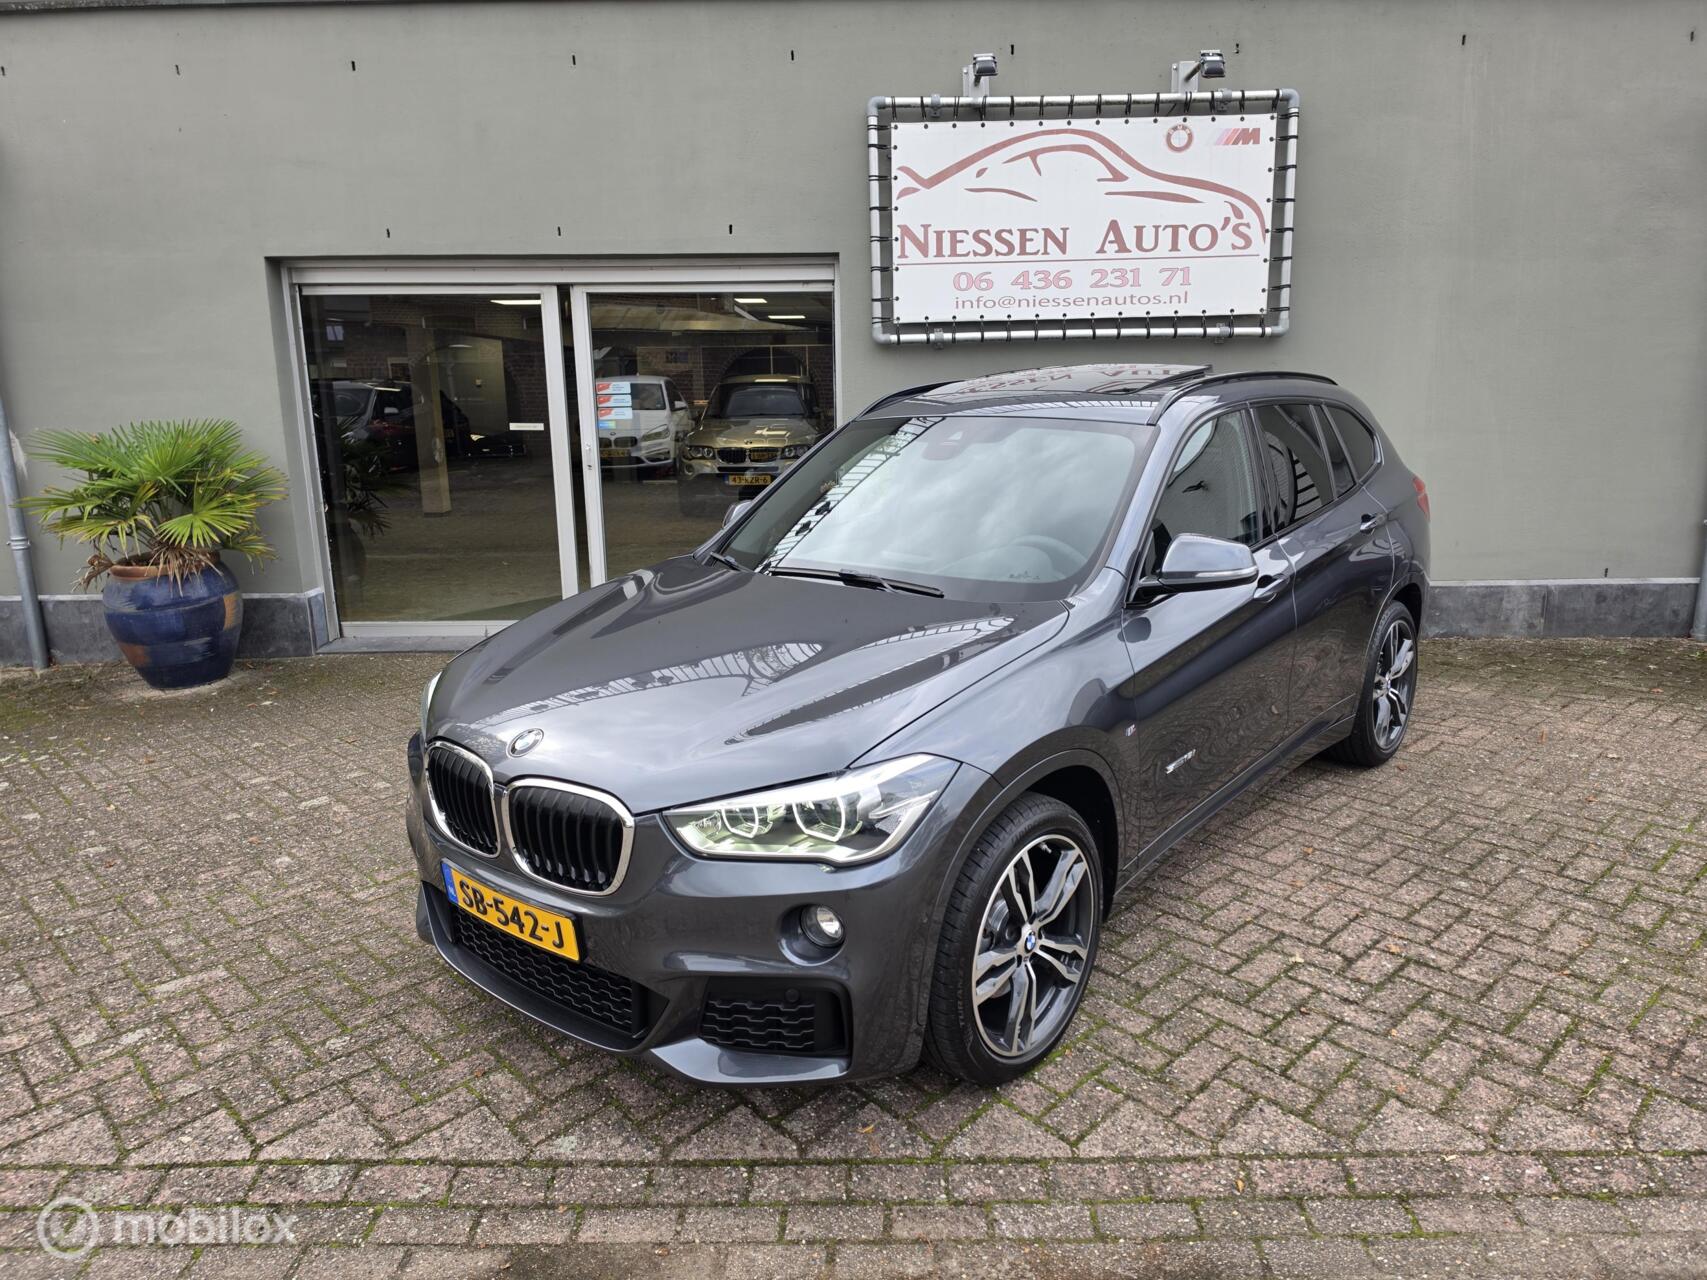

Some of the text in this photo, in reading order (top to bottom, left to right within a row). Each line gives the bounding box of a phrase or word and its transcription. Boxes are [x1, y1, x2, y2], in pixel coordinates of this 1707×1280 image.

[896, 216, 1254, 259] NIESSEN AUTO'S
[952, 266, 1192, 292] 06 436 231 71
[954, 290, 1189, 310] info@niessenautos.nl
[458, 879, 565, 949] SB-542-J
